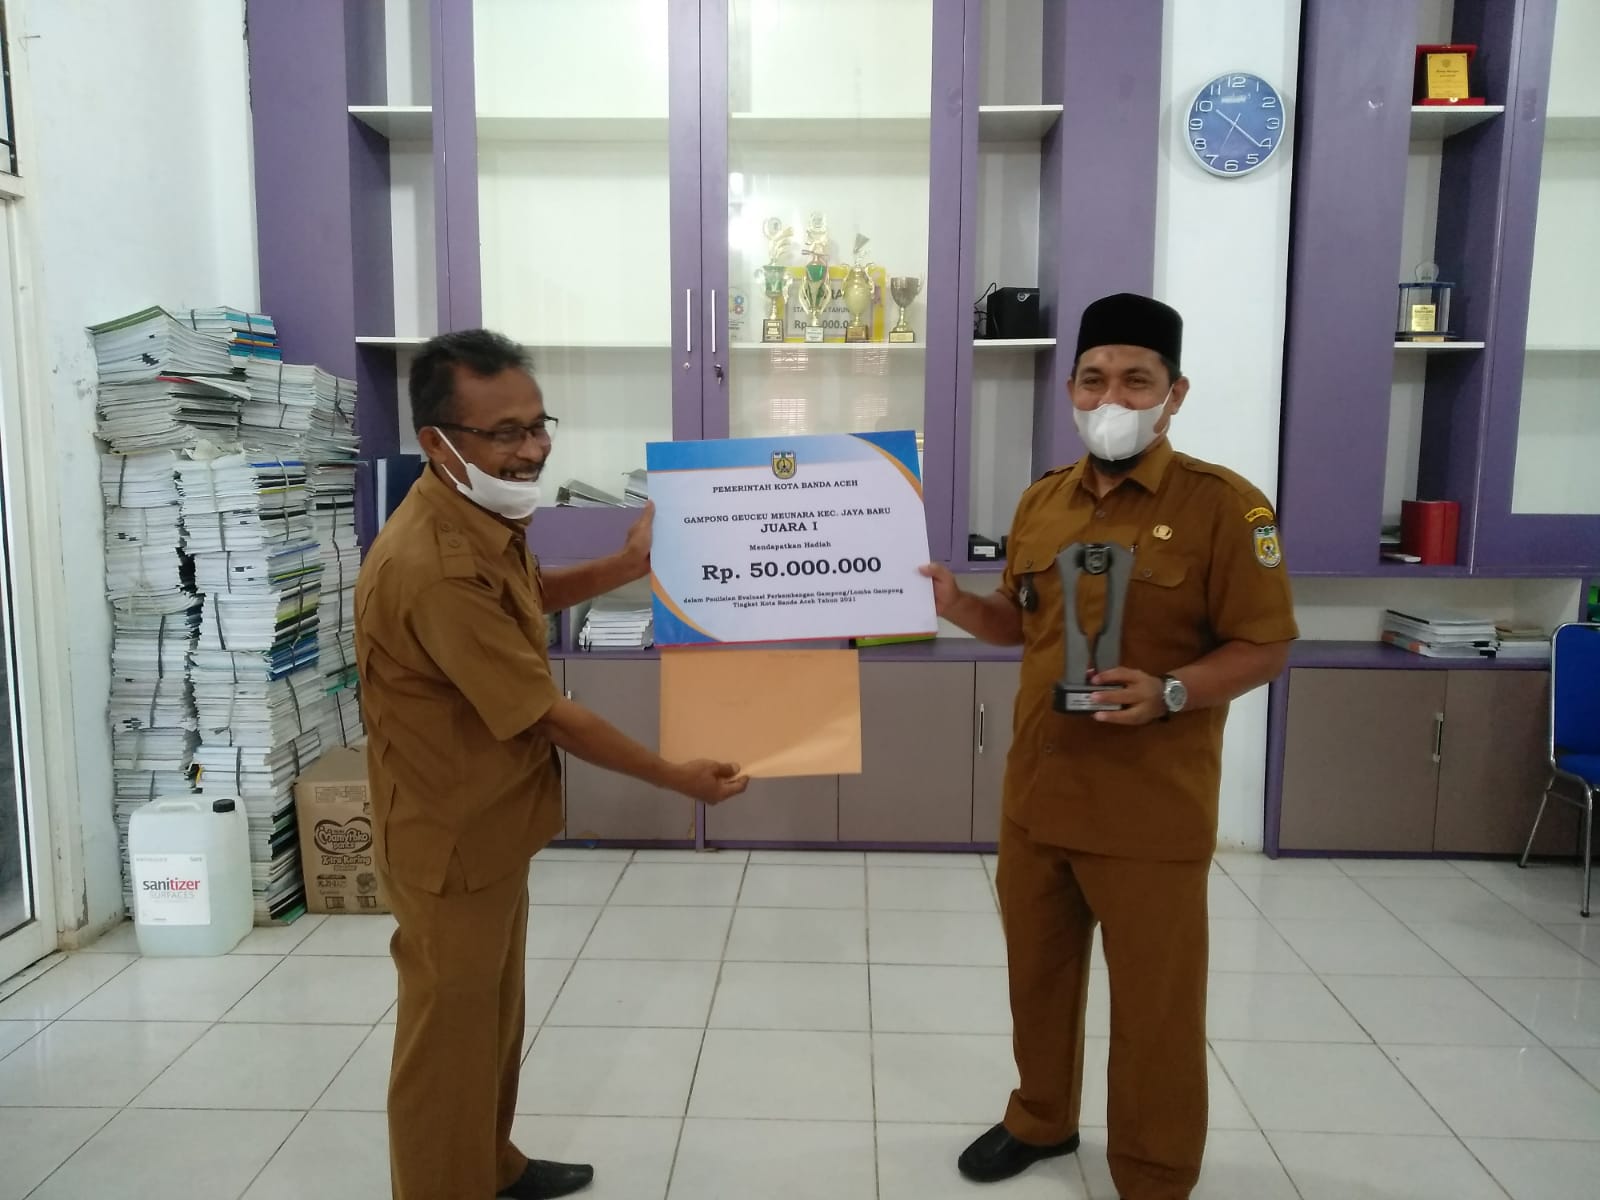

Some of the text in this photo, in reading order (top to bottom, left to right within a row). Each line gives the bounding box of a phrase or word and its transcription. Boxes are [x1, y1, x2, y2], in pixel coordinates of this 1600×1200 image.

[1227, 76, 1246, 88] 12
[1210, 83, 1221, 95] 11
[1195, 100, 1212, 112] 10
[1262, 97, 1276, 108] 2
[1189, 118, 1203, 130] 9
[1266, 117, 1280, 130] 3
[1194, 138, 1207, 150] 8
[1259, 137, 1272, 150] 4
[1205, 154, 1219, 166] 7
[1245, 153, 1259, 165] 5
[1224, 160, 1239, 171] 6
[712, 479, 858, 493] PEMERINTAH KOTA BANDA ACEH
[683, 507, 891, 524] GAMPONG GEUCEU MEUNARA KEC. JAYA BARU
[760, 521, 818, 533] JUARA I
[749, 541, 831, 552] Mendapatkan Hadiah
[701, 556, 882, 584] Rp. 50.000.000
[767, 590, 815, 600] Perkembangan
[816, 588, 872, 598] Gampong/Lomba
[873, 587, 904, 595] Gampong
[733, 601, 758, 609] Tingkat
[343, 855, 371, 866] Kering
[142, 876, 200, 891] sanitizer
